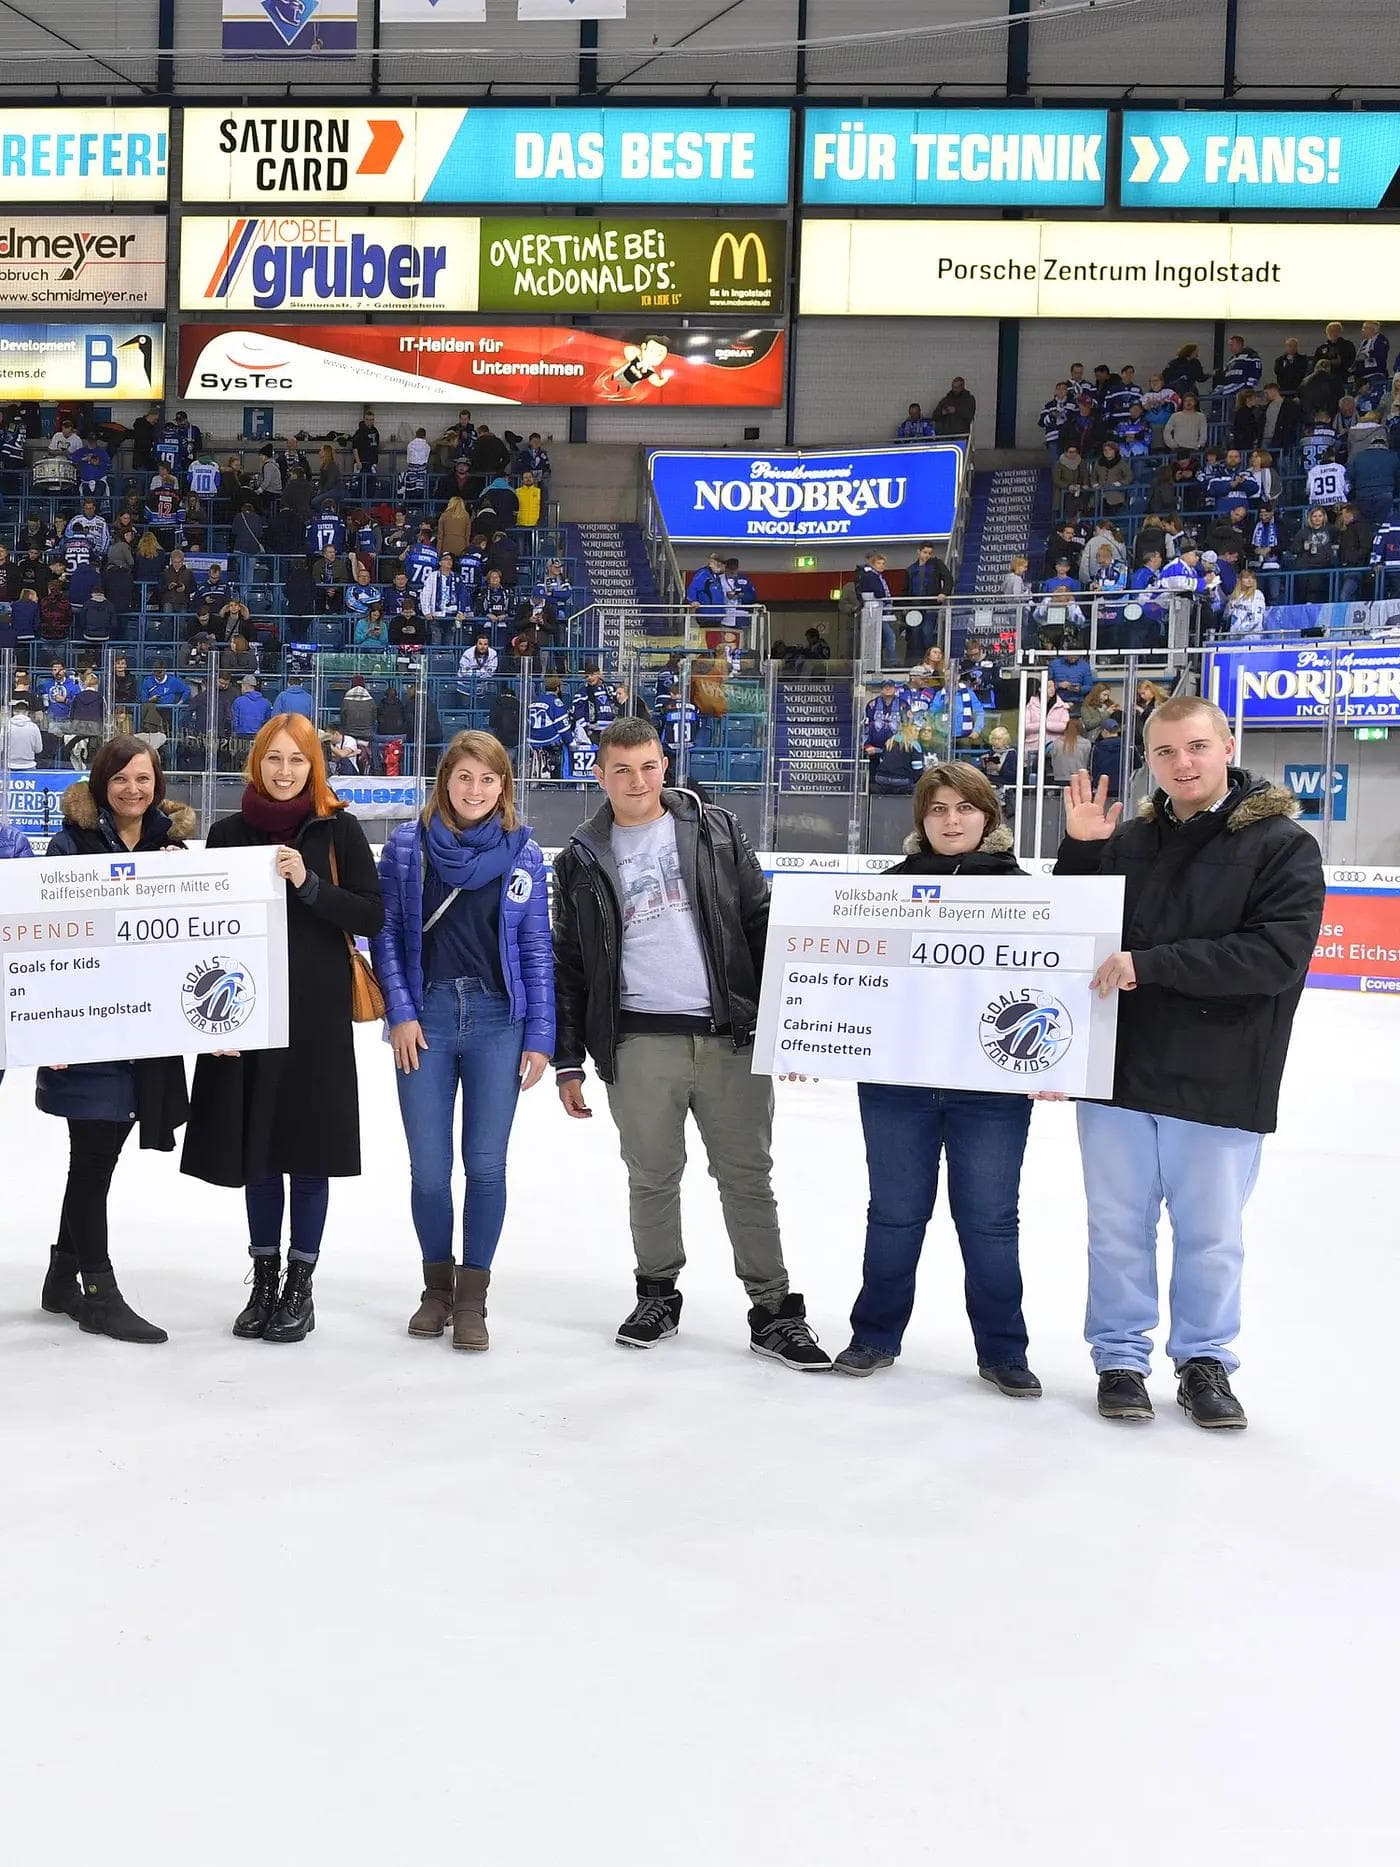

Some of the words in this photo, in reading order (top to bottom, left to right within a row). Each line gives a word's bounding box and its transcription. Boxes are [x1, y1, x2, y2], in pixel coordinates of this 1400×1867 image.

[219, 119, 349, 154] SATURN
[515, 132, 603, 179] DAS
[621, 132, 755, 179] BESTE
[814, 121, 896, 180] FÜR
[911, 133, 1101, 181] TECHNIK
[1205, 136, 1341, 184] FANS!
[256, 158, 348, 191] CARD
[260, 219, 345, 242] MÖBEL
[253, 234, 446, 309] gruber
[938, 258, 1036, 281] Porsche
[1043, 259, 1147, 282] Zentrum
[1155, 260, 1281, 287] Ingolstadt
[0, 288, 148, 305] www.schmidmeyer.net
[731, 289, 771, 298] Ingolstadt
[0, 340, 76, 353] Development
[400, 337, 475, 353] IT-Helden
[479, 337, 503, 353] für
[473, 361, 583, 376] Unternehmen
[200, 373, 292, 391] SysTec
[253, 410, 266, 433] F
[750, 462, 853, 479] Privatbrauerei
[1313, 475, 1336, 495] 39
[694, 477, 906, 517] NORDBRÄU
[748, 520, 851, 535] INGOLSTADT
[573, 752, 596, 770] 32
[1290, 771, 1342, 794] WC
[809, 858, 839, 868] Audi
[40, 870, 99, 884] Volksbank
[41, 884, 129, 900] Raiffeisenbank
[136, 883, 175, 897] Bayern
[180, 881, 210, 892] Mitte
[215, 879, 229, 890] eG
[834, 889, 898, 902] Volksbank
[833, 905, 931, 918] Raiffeisenbank
[939, 906, 984, 920] Bayern
[991, 907, 1026, 919] Mitte
[1032, 908, 1050, 919] eG
[2, 921, 94, 942] SPENDE
[188, 916, 241, 936] Euro
[786, 937, 887, 955] SPENDE
[9, 961, 45, 973] Goals
[49, 959, 69, 971] for
[73, 957, 100, 969] Kids
[996, 945, 1059, 968] Euro
[788, 972, 828, 985] Goals
[833, 973, 854, 986] for
[858, 974, 888, 988] Kids
[10, 987, 25, 996] an
[786, 995, 802, 1005] an
[10, 1007, 84, 1022] Frauenhaus
[88, 1002, 152, 1017] Ingolstadt
[784, 1019, 832, 1033] Cabrini
[838, 1022, 872, 1035] Haus
[781, 1039, 871, 1056] Offenstetten
